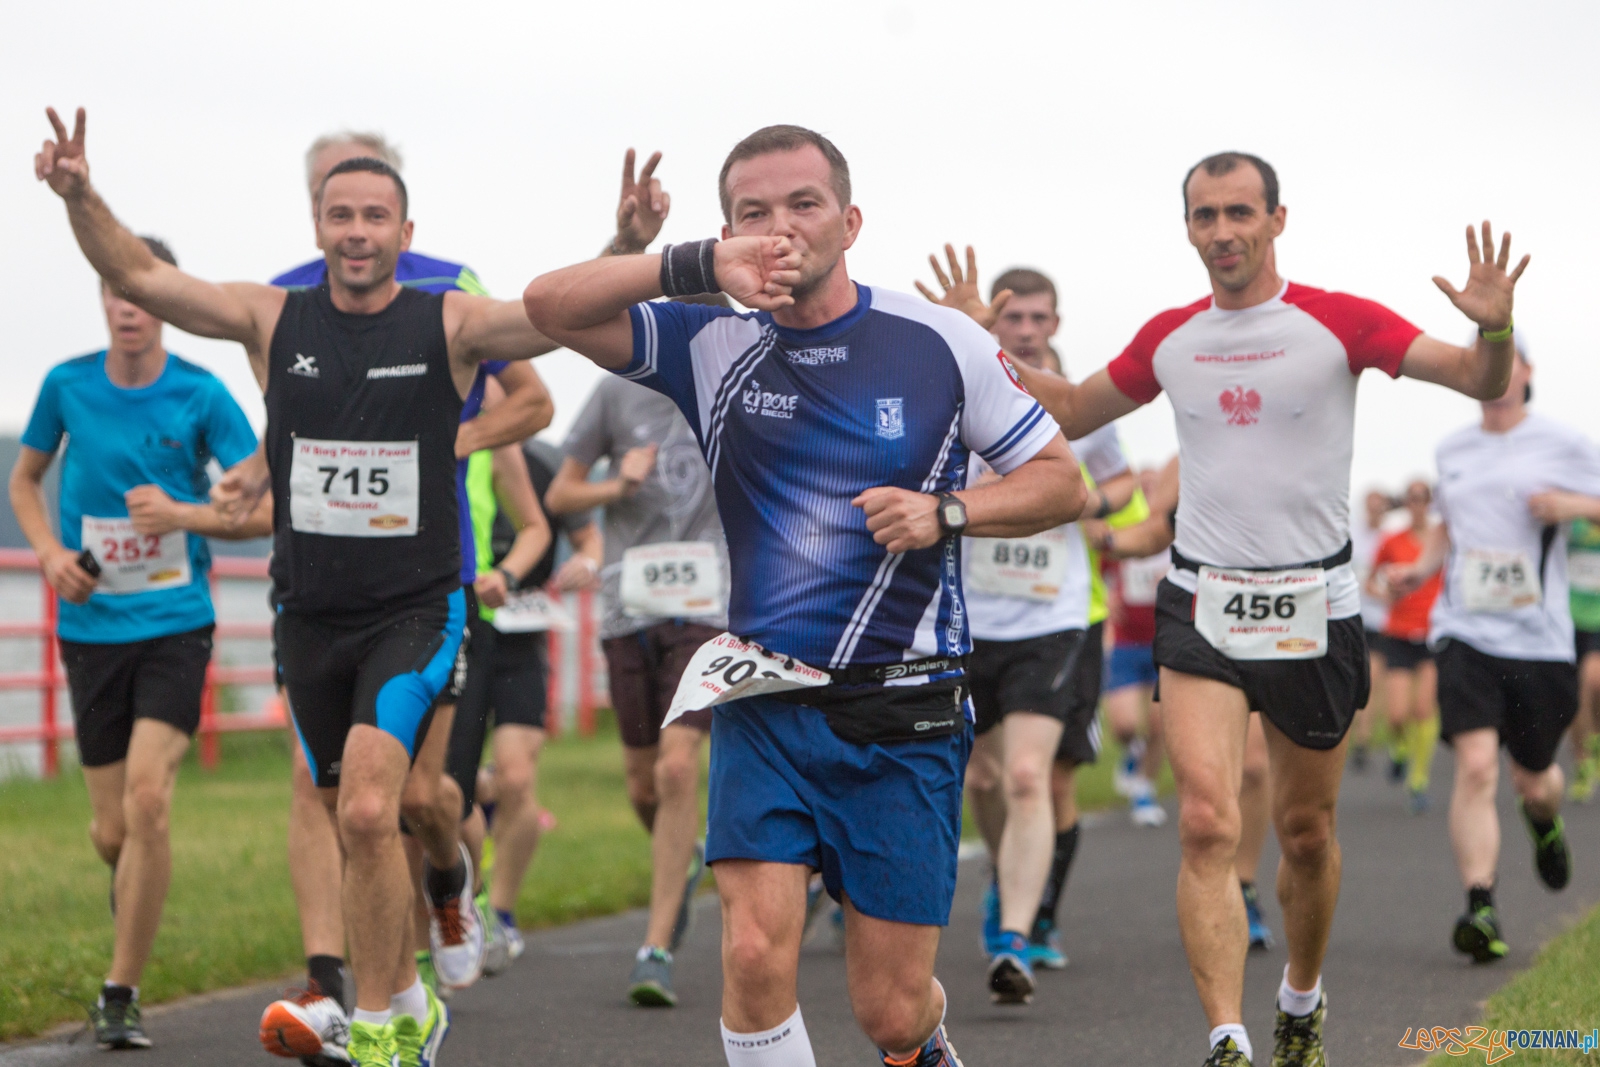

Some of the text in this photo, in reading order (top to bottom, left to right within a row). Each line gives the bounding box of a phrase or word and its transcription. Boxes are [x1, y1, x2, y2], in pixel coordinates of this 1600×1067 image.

[744, 406, 793, 419] W BIEGU
[313, 446, 337, 458] Bieg
[318, 466, 390, 497] 715
[103, 535, 160, 562] 252
[992, 542, 1050, 569] 898
[643, 562, 698, 587] 955
[1223, 592, 1297, 621] 456
[712, 637, 750, 652] IV Bieg
[909, 661, 949, 673] Kalenji
[728, 1028, 790, 1047] moose
